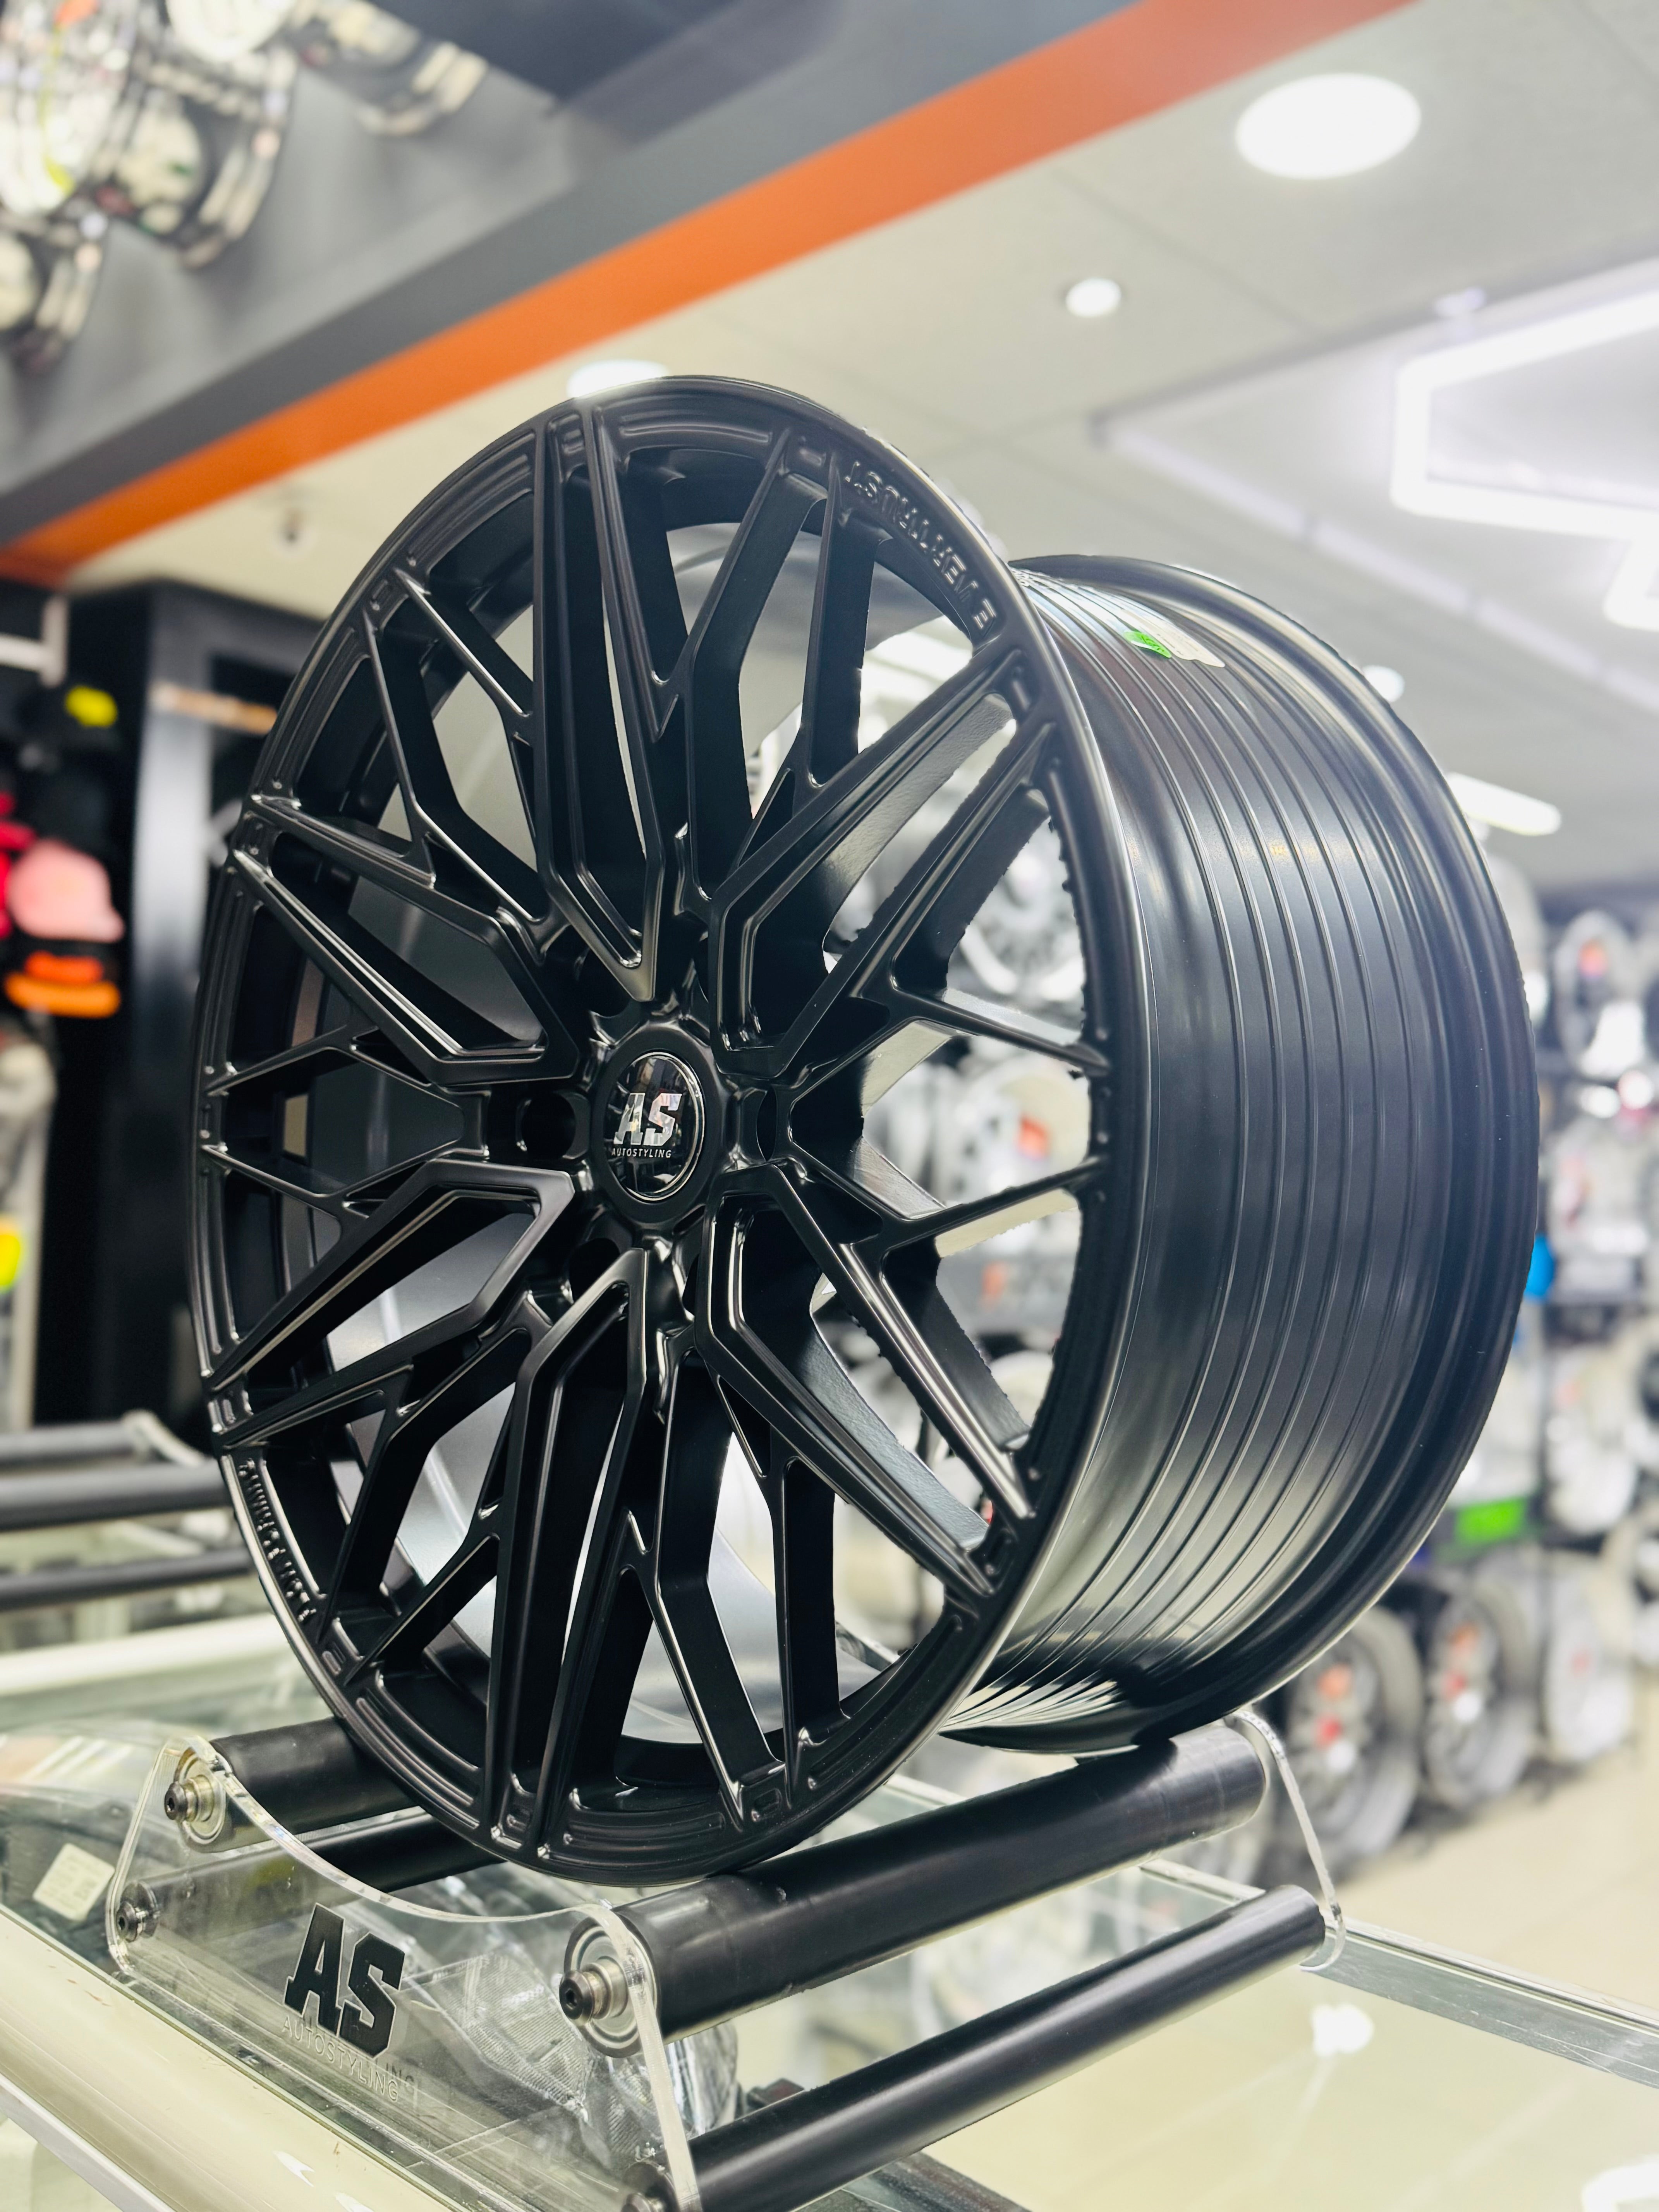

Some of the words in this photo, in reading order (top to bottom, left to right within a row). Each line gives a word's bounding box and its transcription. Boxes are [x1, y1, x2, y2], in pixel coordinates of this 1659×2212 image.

[612, 1148, 672, 1158] AUTOSTYLING
[613, 1093, 682, 1146] AS
[283, 1902, 405, 2059] AS
[282, 2015, 399, 2102] AUTOSTYLING
